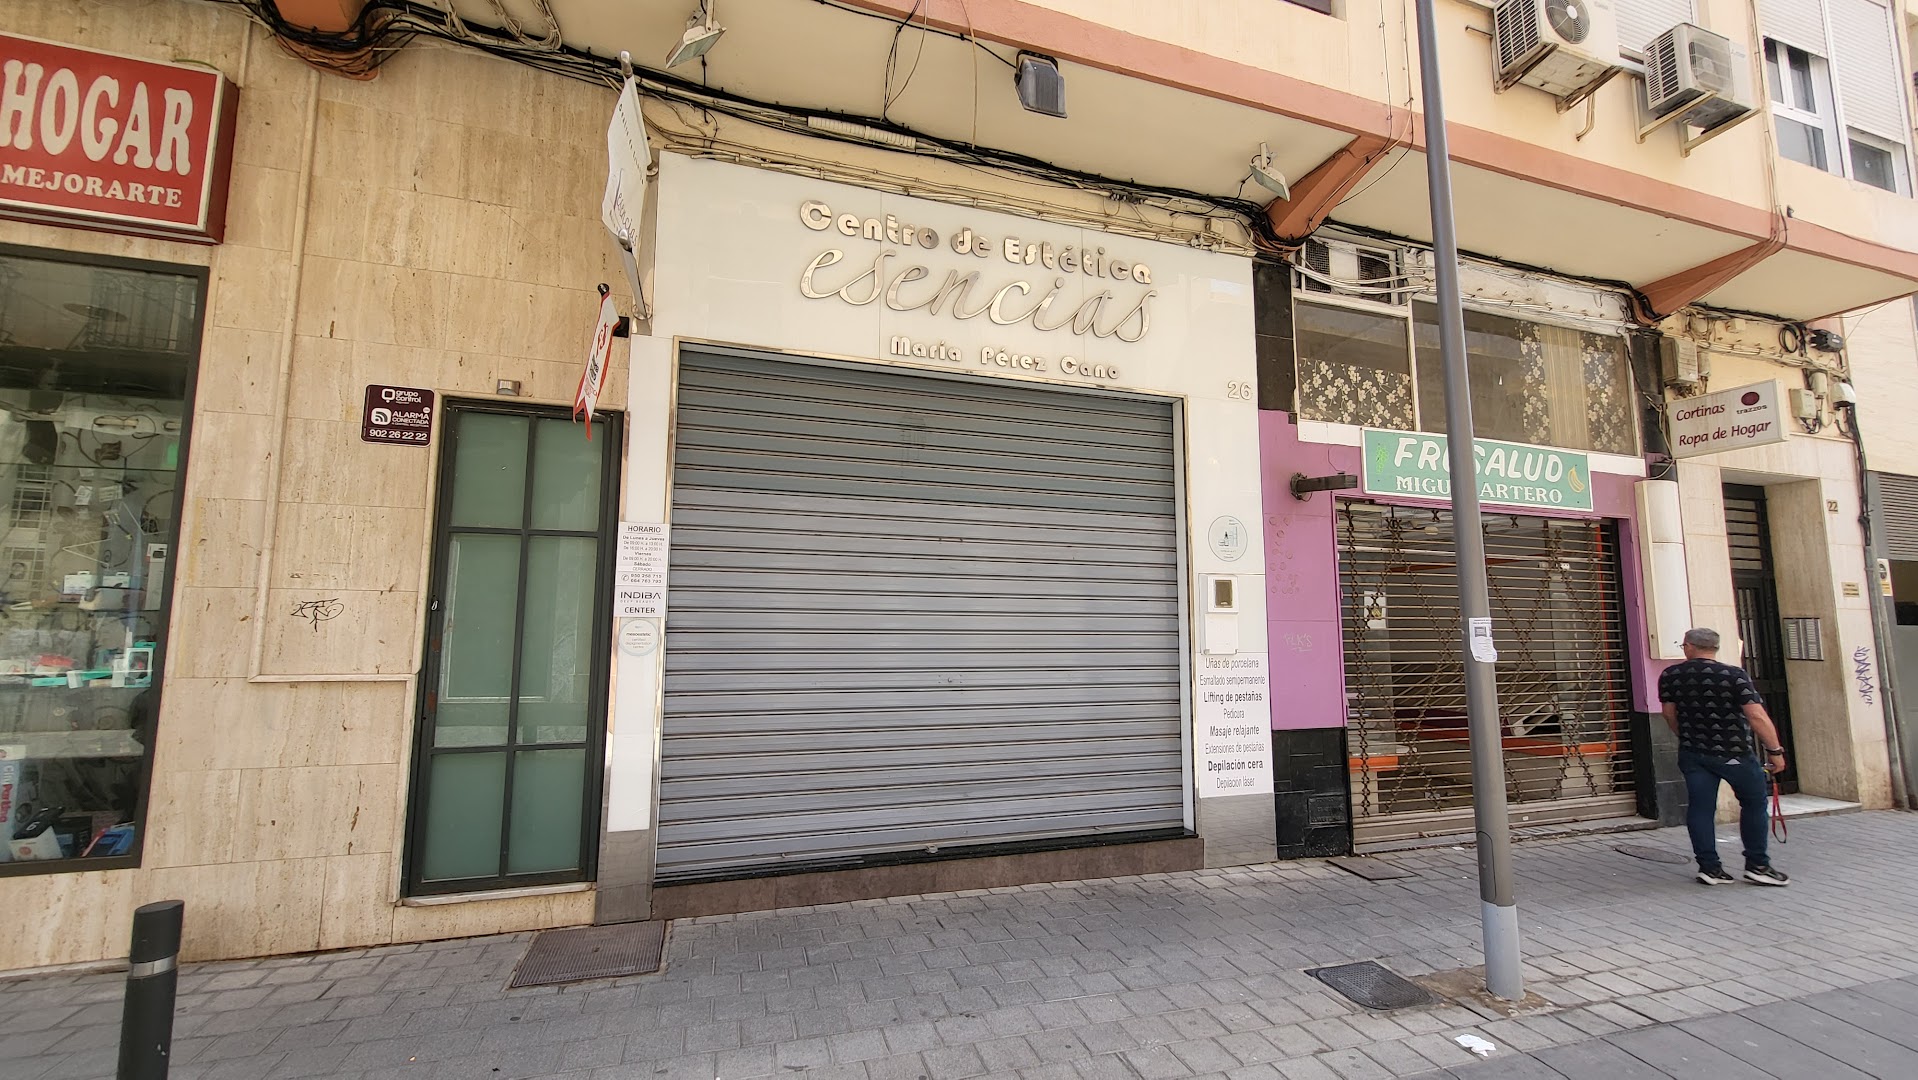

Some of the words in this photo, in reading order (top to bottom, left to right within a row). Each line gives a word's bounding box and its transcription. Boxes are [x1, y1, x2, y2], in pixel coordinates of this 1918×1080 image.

[0, 59, 194, 176] HOGAR
[1, 163, 182, 208] MEJORARTE
[799, 199, 940, 251] Centro
[949, 226, 993, 259] de
[1003, 235, 1153, 285] Estética
[799, 247, 1158, 343] esencias
[889, 334, 963, 362] María
[980, 346, 1048, 372] Pérez
[1059, 355, 1121, 380] Cano
[1227, 380, 1254, 400] 26
[392, 411, 430, 420] ALARMA
[1676, 404, 1725, 422] Cortinas
[392, 417, 430, 425] CONECTADA
[369, 429, 387, 437] 902
[388, 431, 401, 439] 26
[402, 432, 414, 440] 22
[415, 433, 428, 441] 22
[1678, 433, 1709, 448] Ropa
[1712, 429, 1728, 440] de
[1730, 420, 1772, 439] Hogar
[1479, 483, 1563, 504] ARTERO
[1827, 501, 1838, 512] 22
[628, 525, 661, 533] HORARIO
[620, 592, 661, 600] INDIBA
[1205, 658, 1221, 669] Uñas
[1222, 658, 1230, 668] de
[1231, 659, 1259, 671] porcelana
[1200, 675, 1225, 686] Esmaltado
[1226, 676, 1265, 688] semipermanente
[1204, 692, 1224, 705] Lifting
[1226, 692, 1233, 701] de
[1235, 691, 1262, 704] pestañas
[1210, 726, 1231, 739] Masaje
[1233, 725, 1260, 739] relajante
[1206, 743, 1235, 754] Extensiones
[1236, 743, 1242, 752] de
[1243, 742, 1265, 755] pestañas
[1208, 759, 1246, 774] Depilación
[1248, 759, 1264, 769] cera
[1217, 776, 1243, 791] Depilación
